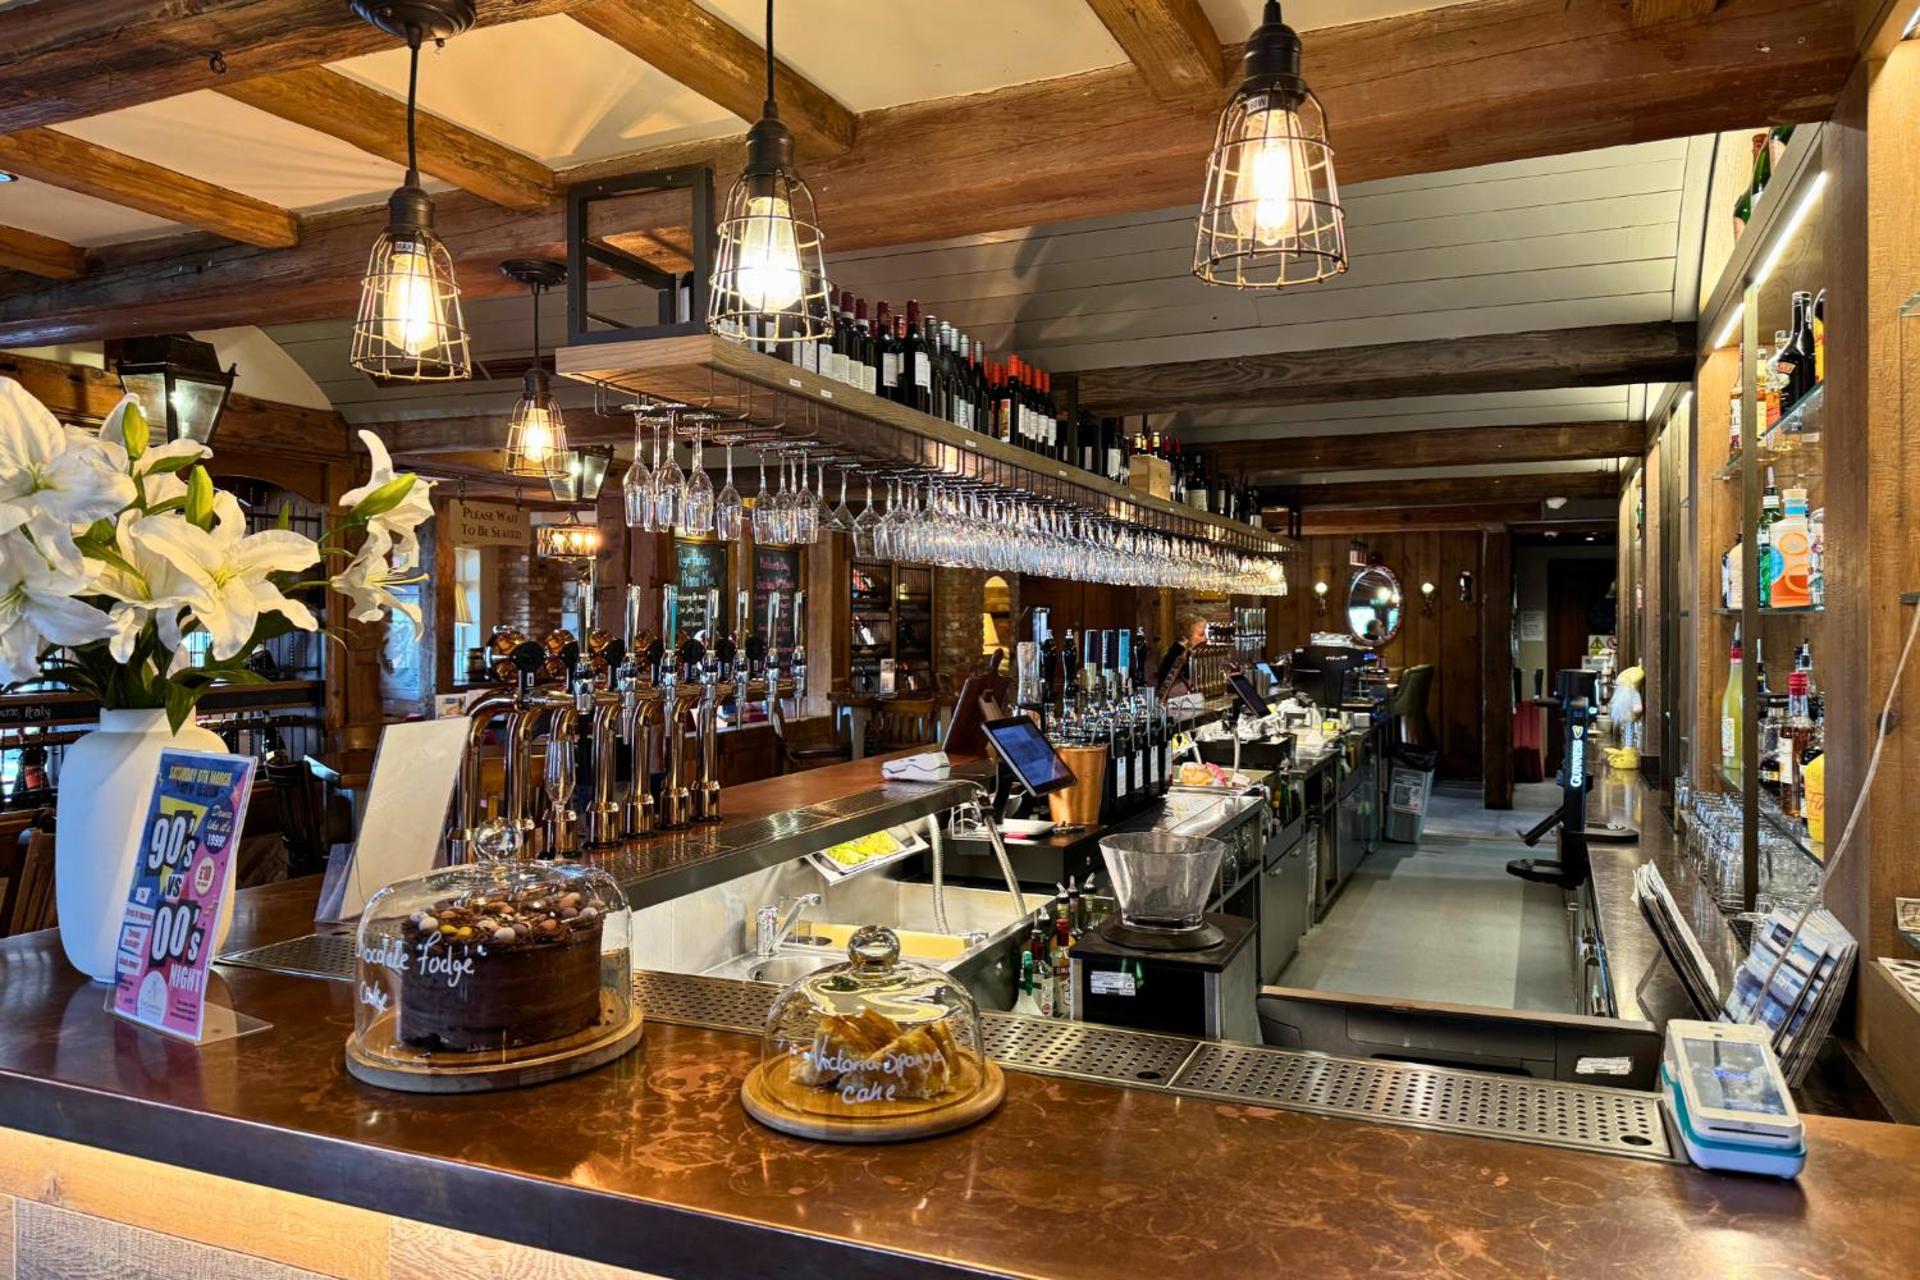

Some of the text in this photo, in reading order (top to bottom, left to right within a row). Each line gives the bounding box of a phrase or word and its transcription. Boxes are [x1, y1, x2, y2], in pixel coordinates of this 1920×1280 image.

[148, 815, 196, 870] 90's
[166, 876, 182, 897] VS
[151, 905, 201, 961] 00's
[168, 963, 203, 993] NIGHT
